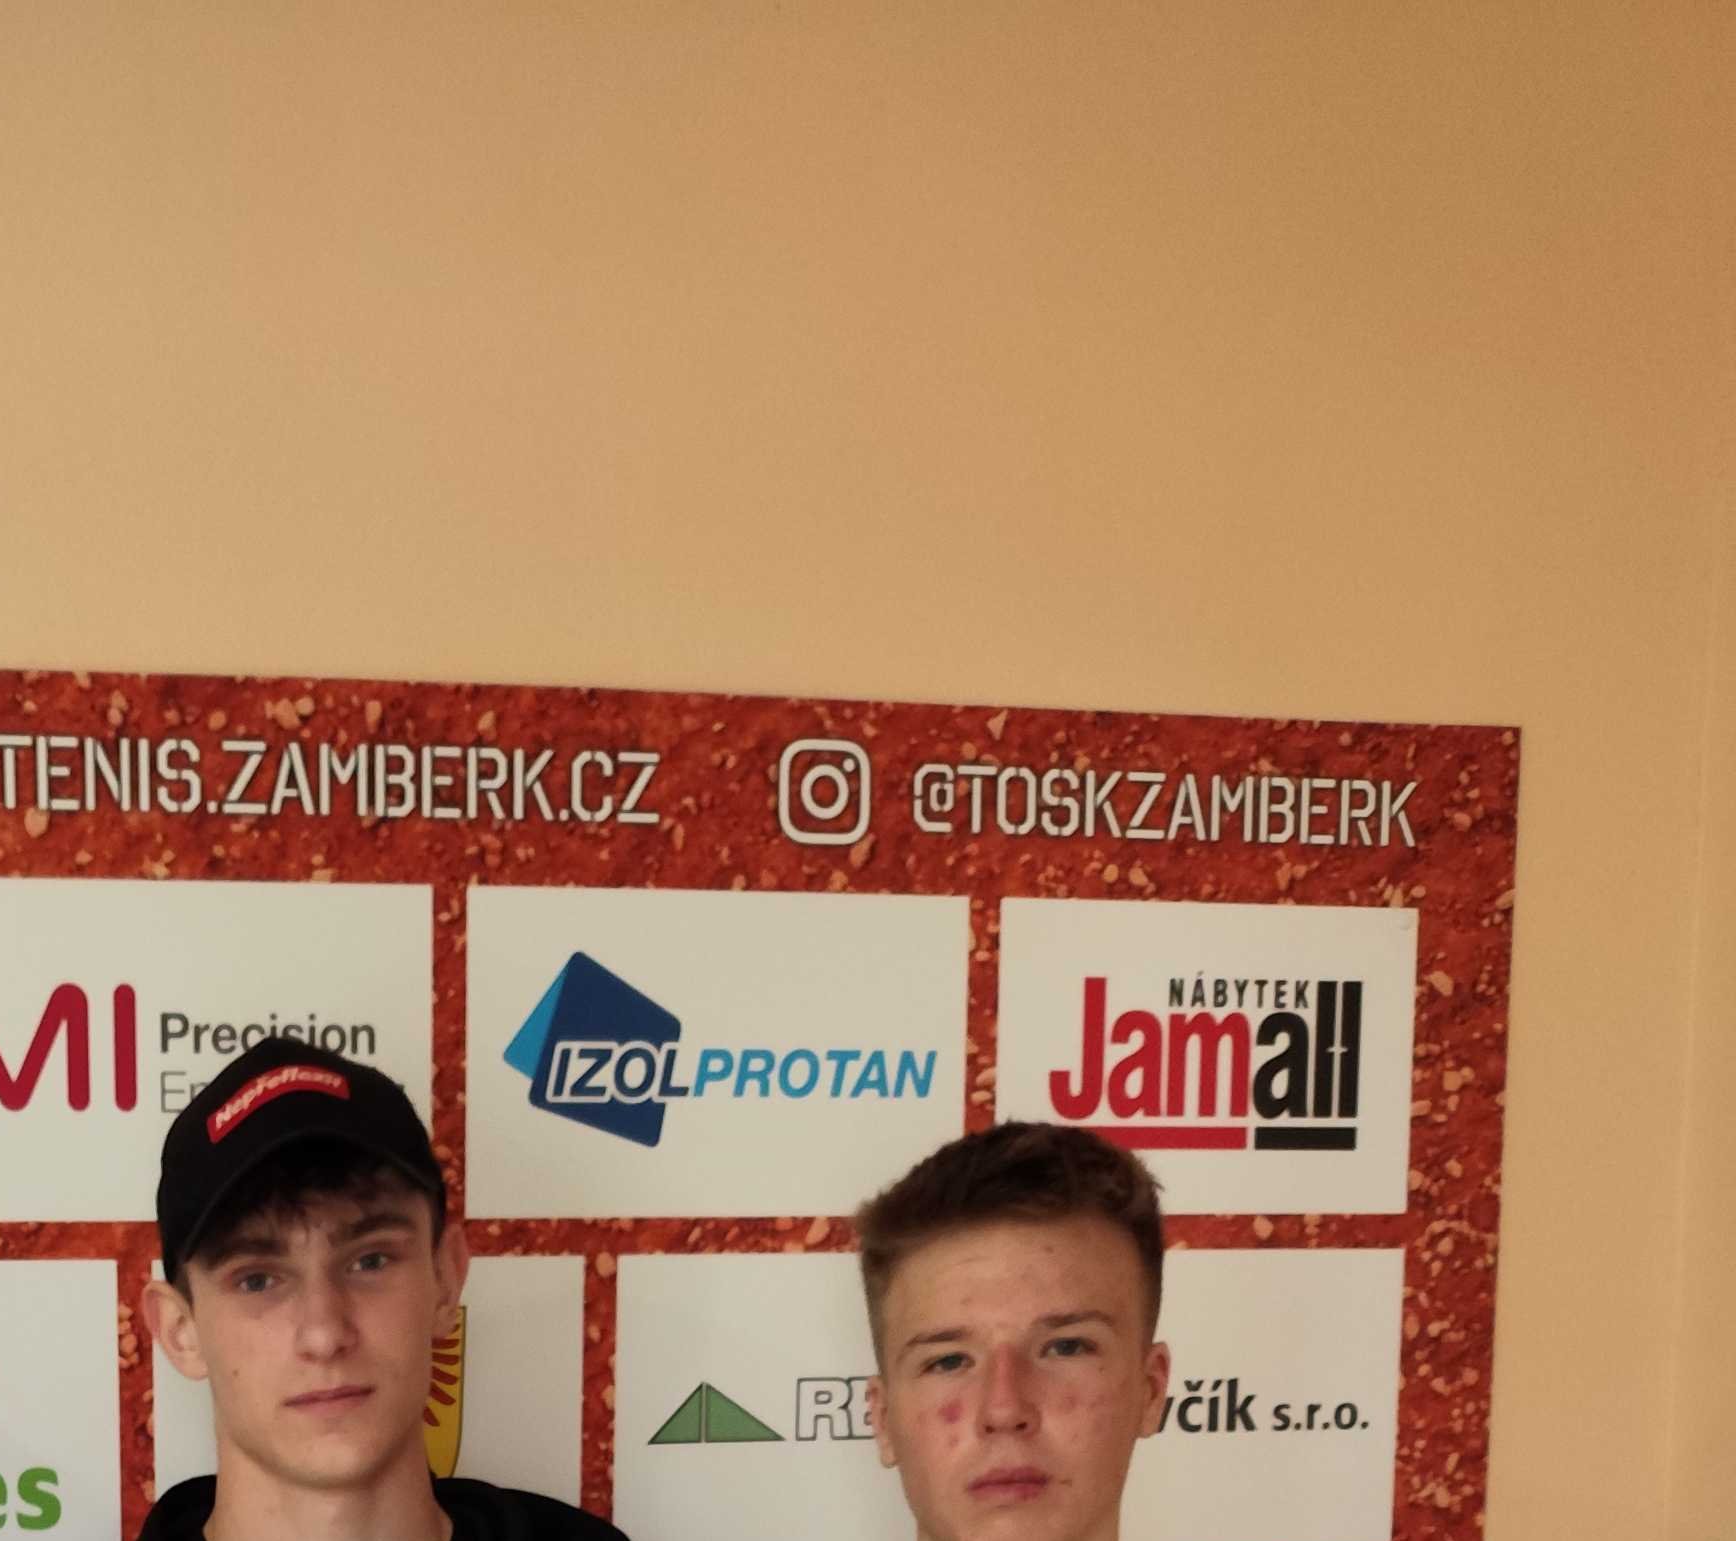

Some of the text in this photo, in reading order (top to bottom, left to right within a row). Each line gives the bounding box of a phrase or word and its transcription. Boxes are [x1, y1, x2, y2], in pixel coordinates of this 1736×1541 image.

[913, 762, 1418, 848] @TOSKZAMBERK
[1168, 972, 1310, 1010] NÁBYTEK
[549, 1046, 937, 1100] IZOLPROTAN
[1049, 976, 1363, 1121] Jamall
[1270, 1401, 1370, 1432] s.r.o.
